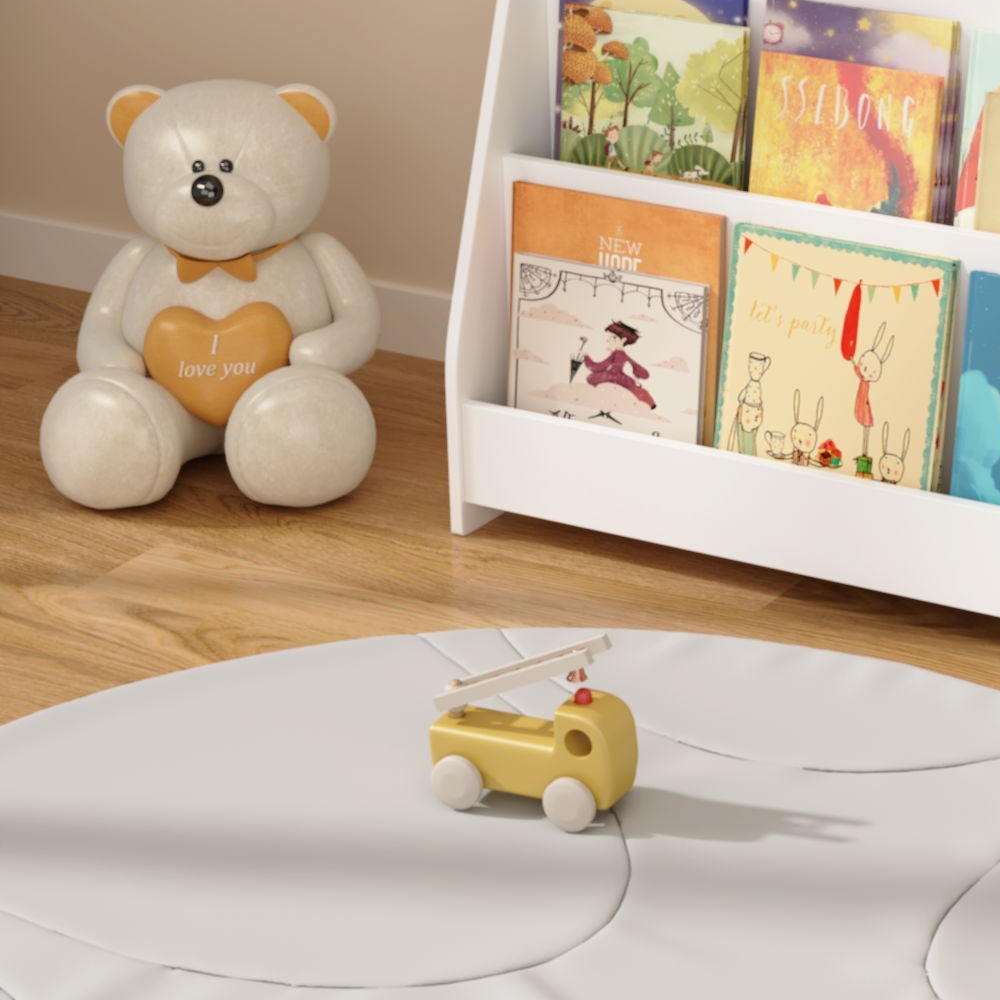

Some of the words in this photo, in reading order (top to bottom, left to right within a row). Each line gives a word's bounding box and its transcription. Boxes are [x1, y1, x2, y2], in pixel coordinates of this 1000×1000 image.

[775, 75, 916, 138] SSEBONG
[598, 235, 643, 256] NEW
[749, 299, 784, 327] let's
[786, 314, 836, 350] party
[210, 333, 219, 356] I
[177, 361, 216, 379] love
[219, 361, 256, 381] you
